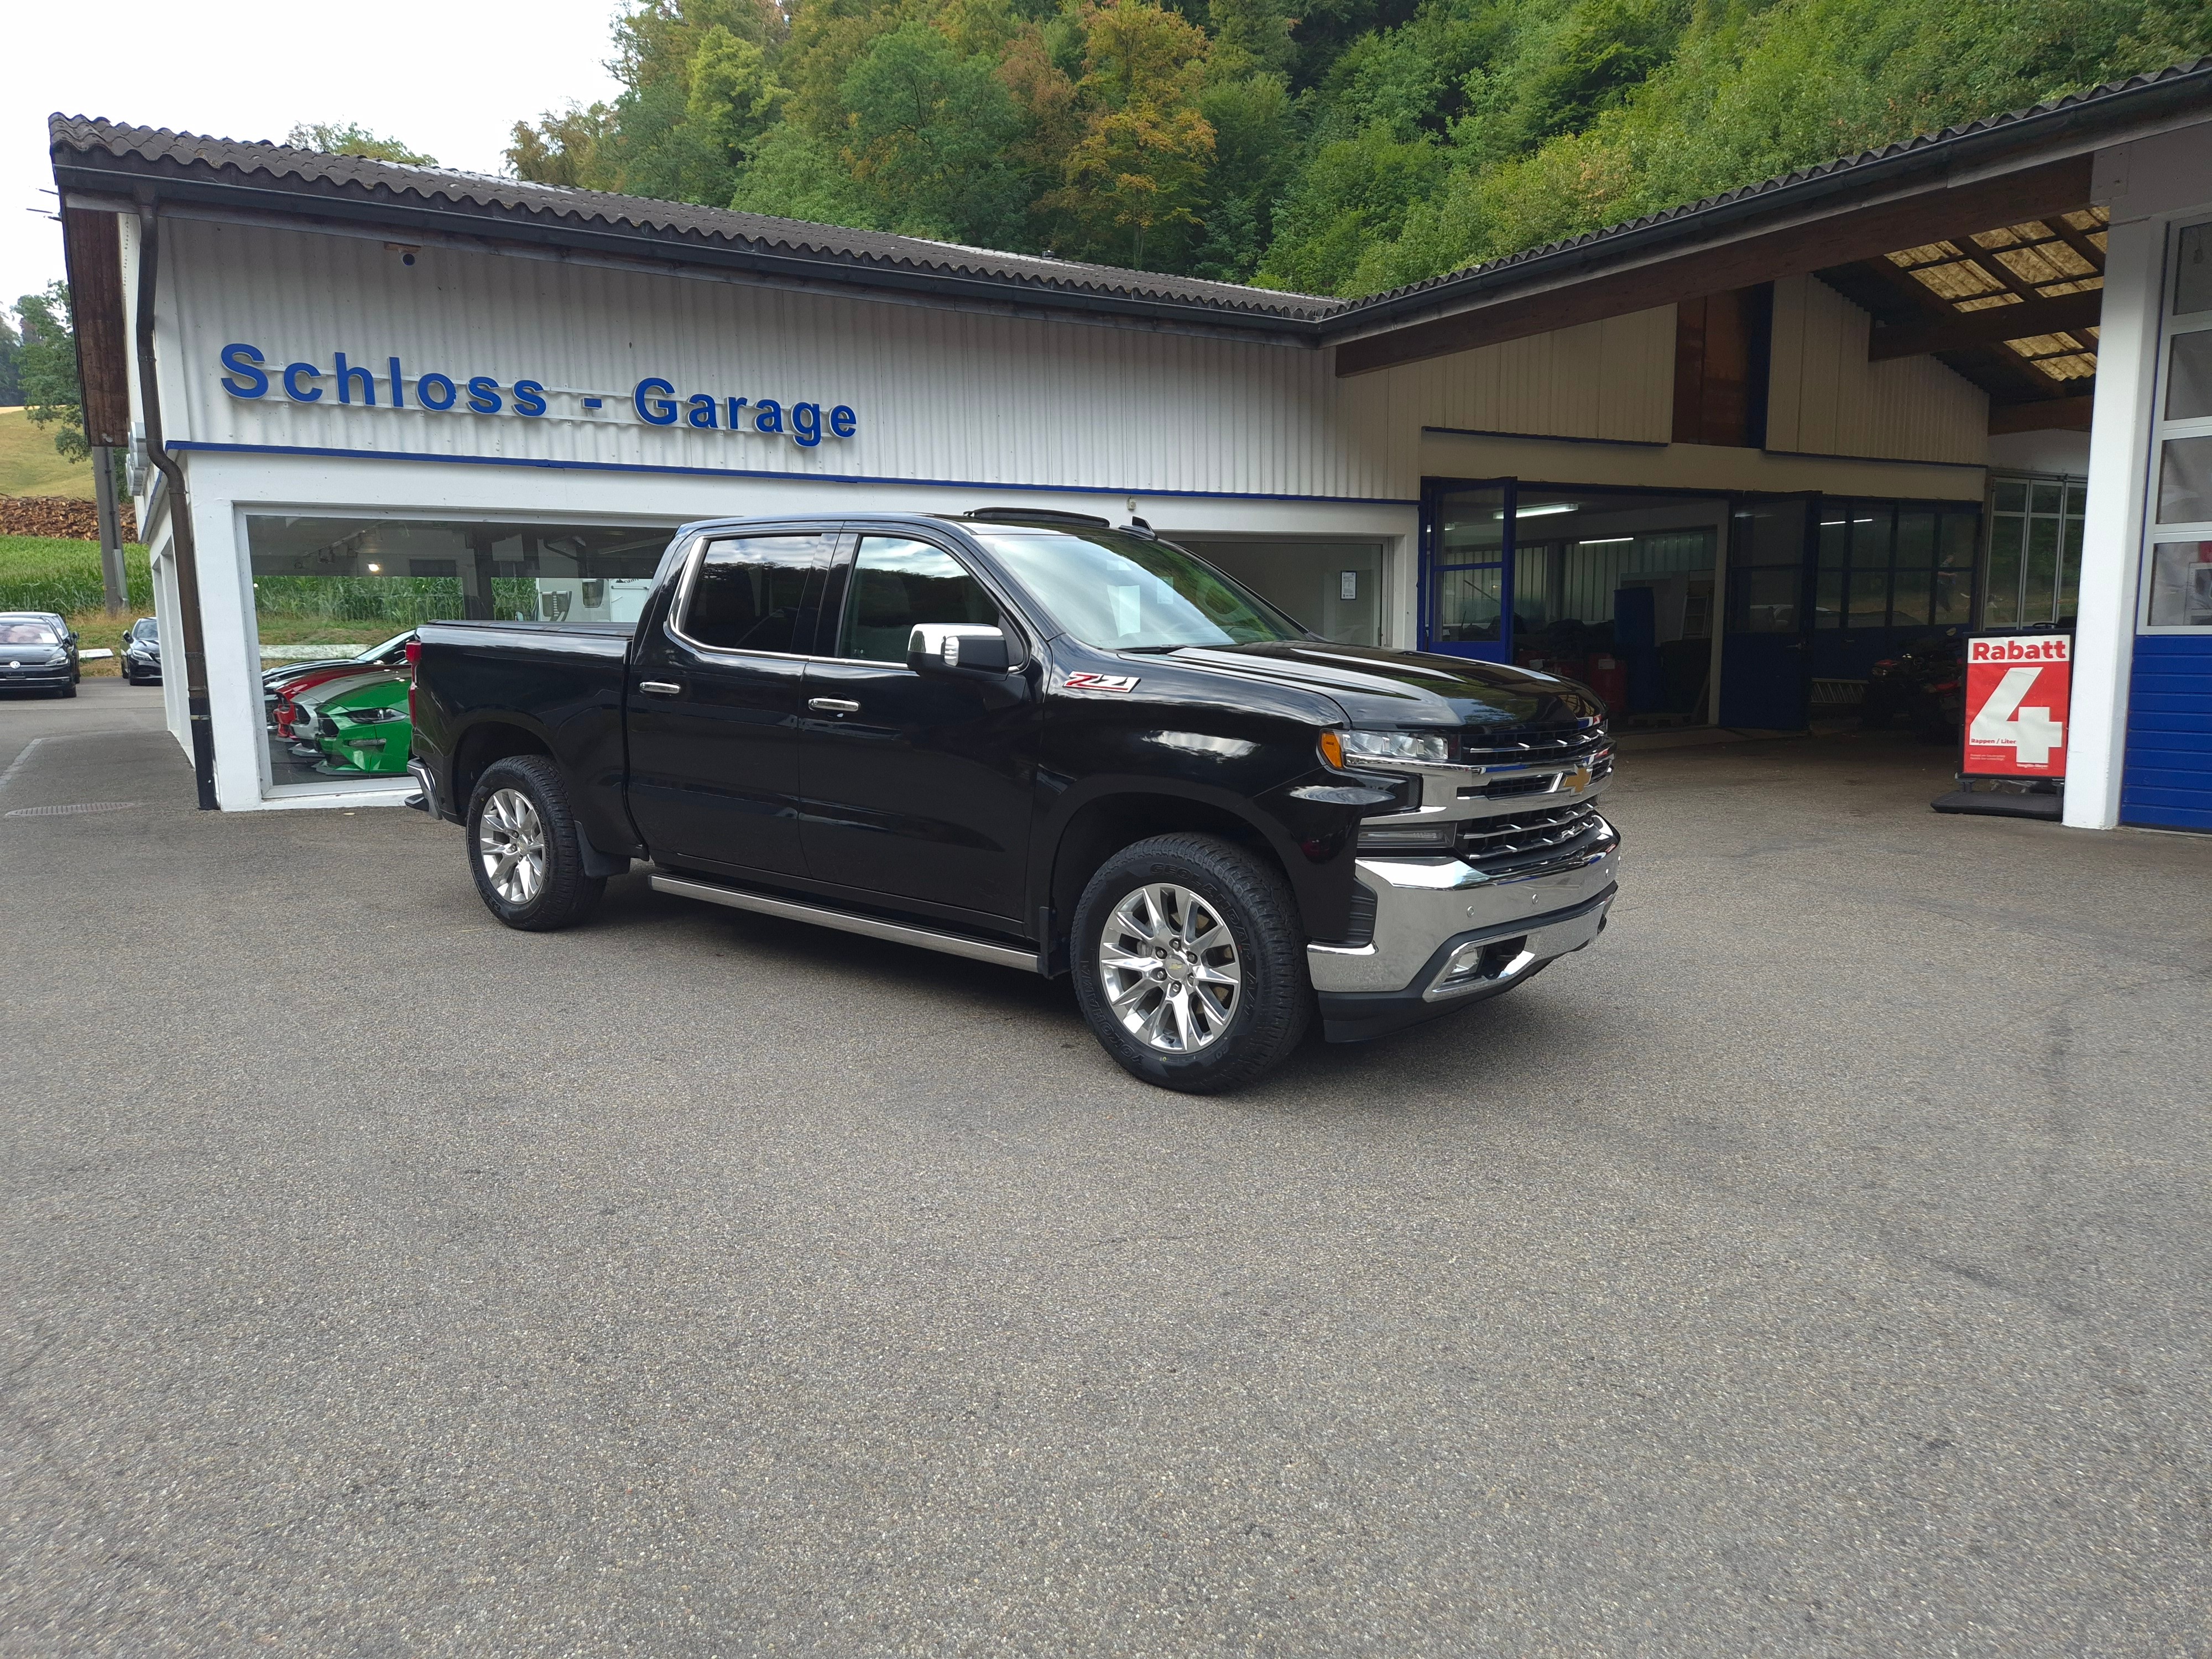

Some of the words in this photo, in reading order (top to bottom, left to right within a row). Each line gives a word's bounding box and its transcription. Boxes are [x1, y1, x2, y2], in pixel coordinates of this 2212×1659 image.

[220, 342, 546, 417] Schloss
[633, 377, 857, 447] Garage
[1973, 640, 2066, 660] Rabatt
[1063, 671, 1141, 693] Z71
[1970, 667, 2062, 763] 4
